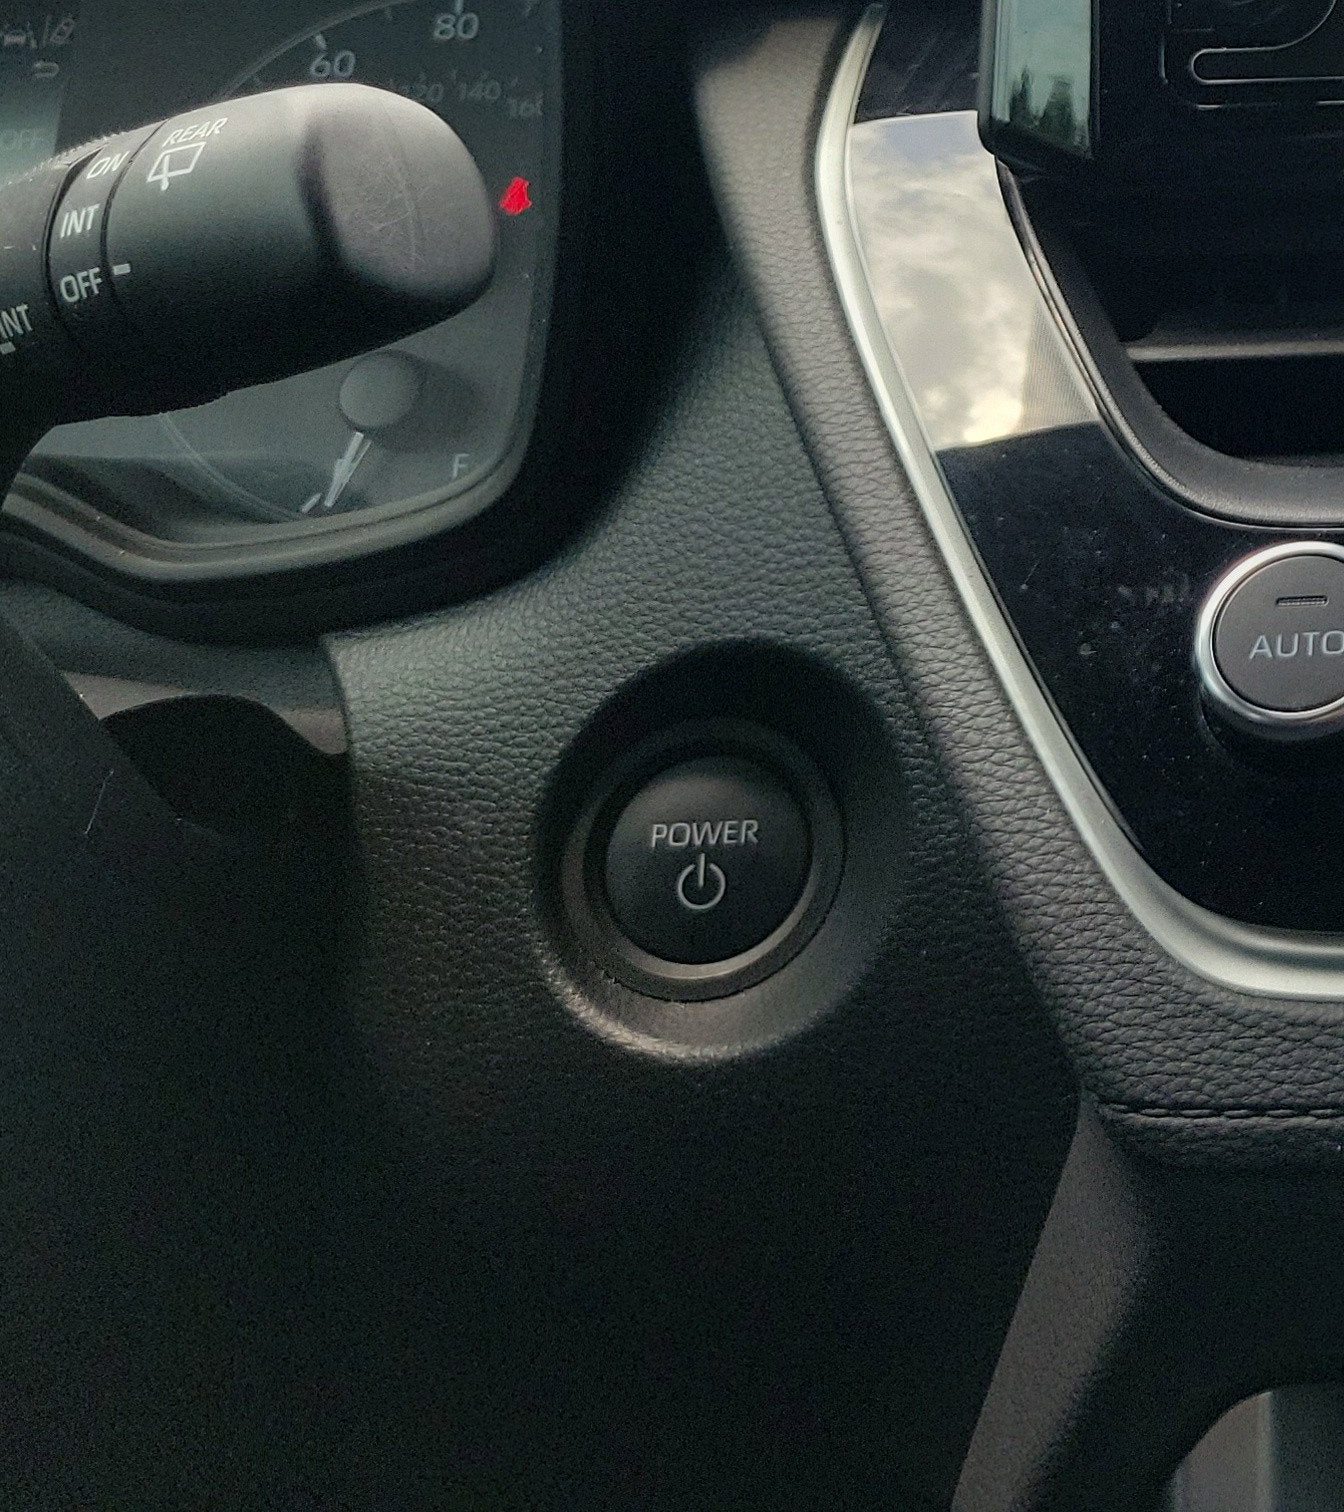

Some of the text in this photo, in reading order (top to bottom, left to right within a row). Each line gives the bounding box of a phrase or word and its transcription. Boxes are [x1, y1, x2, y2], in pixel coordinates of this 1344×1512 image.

[433, 12, 480, 40] 80
[309, 49, 357, 78] 60
[161, 117, 229, 149] REAR
[86, 150, 131, 180] ON
[60, 204, 101, 239] INT
[60, 267, 103, 303] OFF
[453, 453, 470, 477] F
[650, 819, 759, 848] POWER
